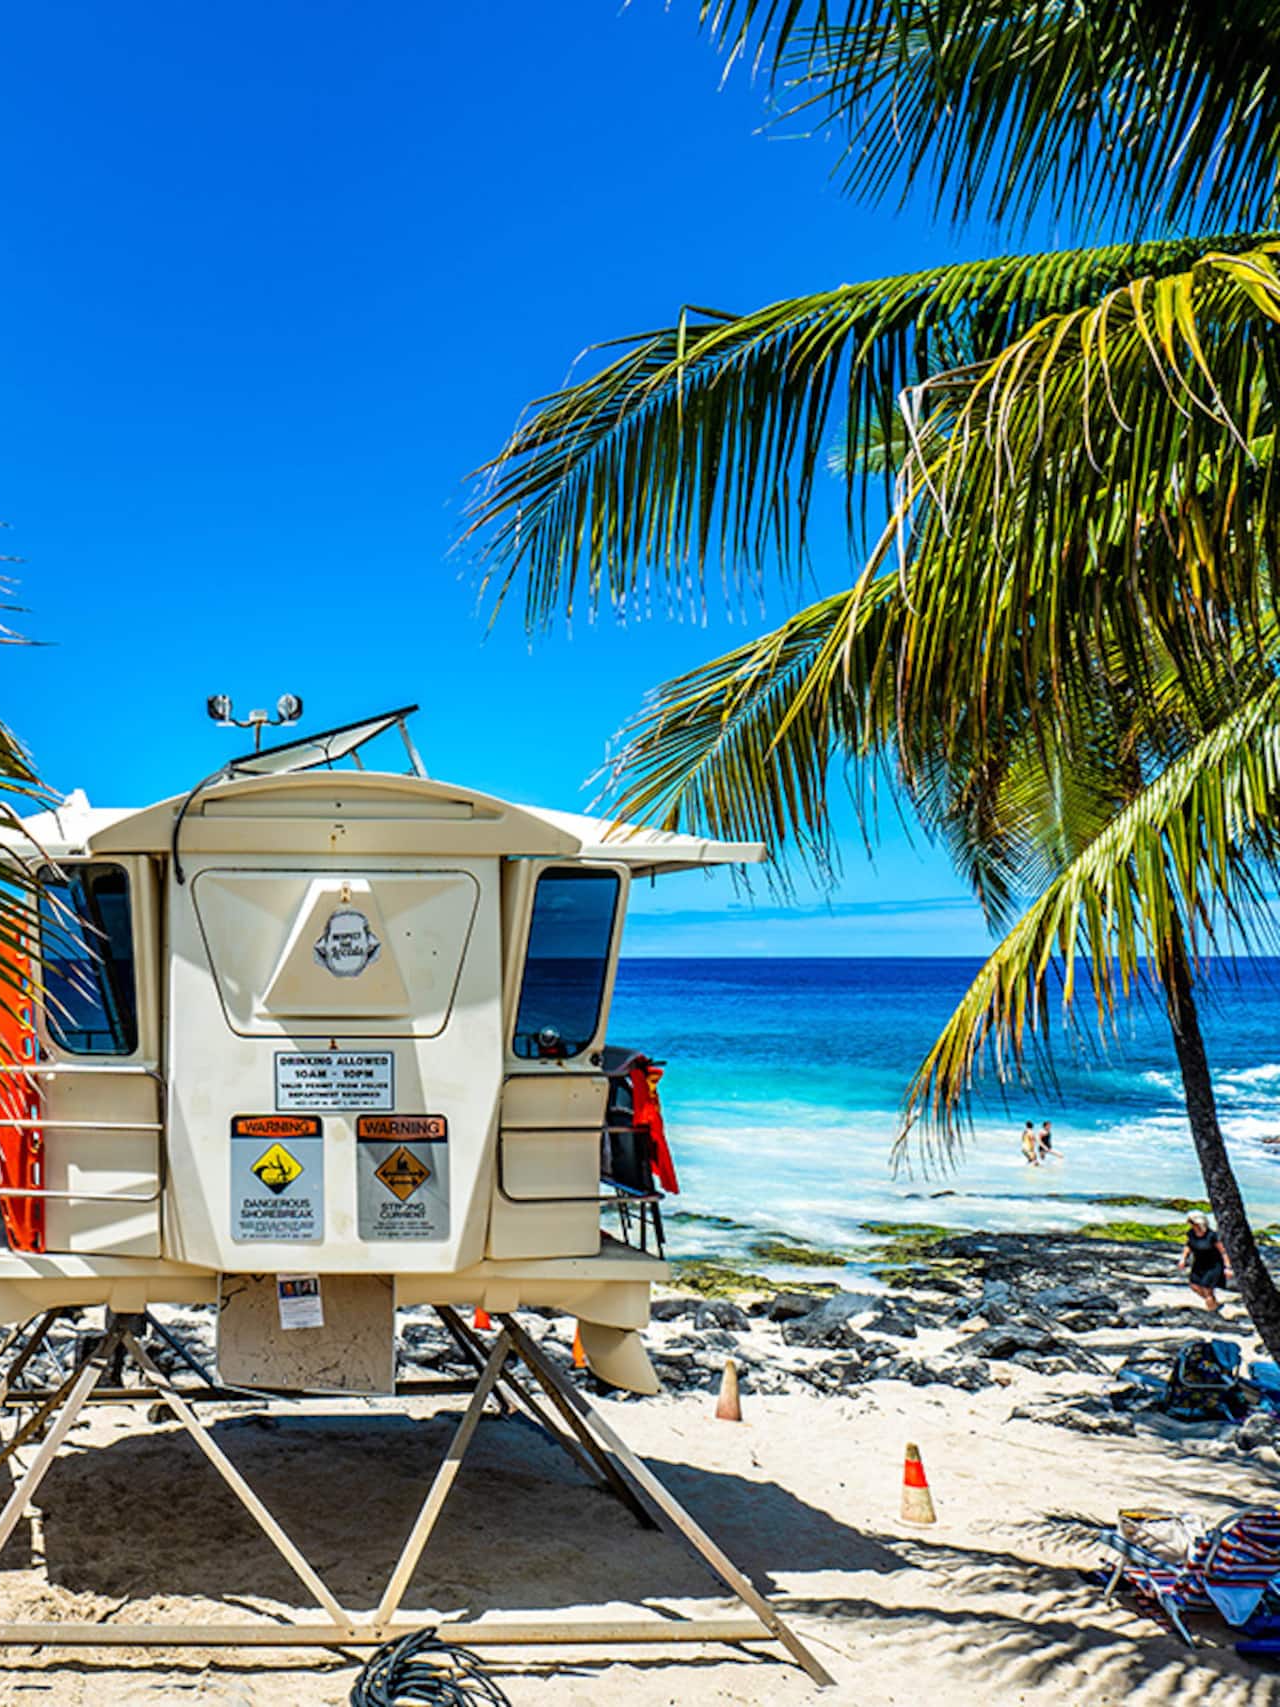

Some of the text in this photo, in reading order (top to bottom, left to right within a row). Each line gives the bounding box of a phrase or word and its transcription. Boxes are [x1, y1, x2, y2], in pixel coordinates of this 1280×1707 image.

[280, 1057, 389, 1066] DRINKING ALLOWED
[295, 1069, 327, 1079] 10AM
[343, 1069, 374, 1079] 10PM
[244, 1120, 311, 1134] WARNING
[363, 1120, 440, 1135] WARNING
[243, 1198, 310, 1208] DANGEROUS
[381, 1202, 426, 1212] STRONG
[241, 1209, 314, 1218] SHOREBREAK
[379, 1210, 426, 1219] CURRENT
